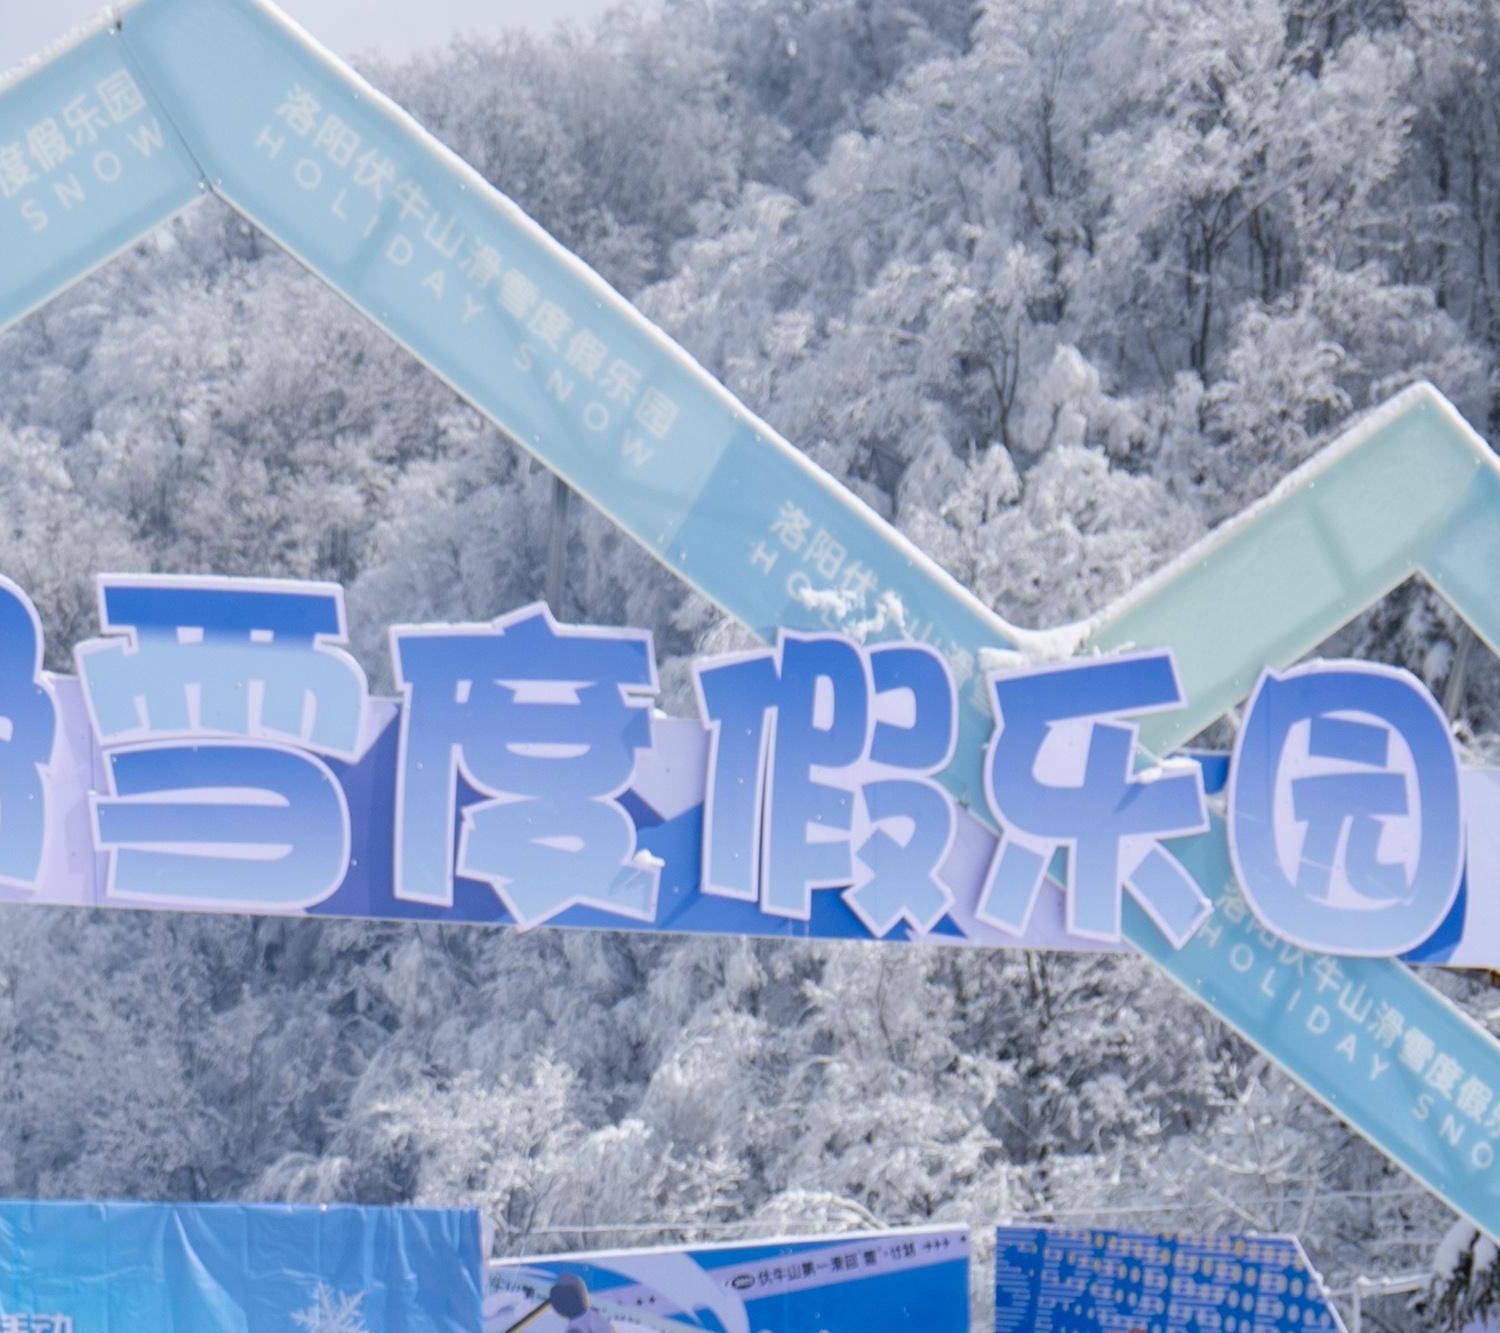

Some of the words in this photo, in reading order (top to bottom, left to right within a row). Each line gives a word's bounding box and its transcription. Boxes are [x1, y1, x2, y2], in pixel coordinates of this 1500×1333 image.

[20, 118, 166, 232] SNOW
[255, 124, 485, 325] HOLIDAY
[513, 341, 657, 468] SNOW
[276, 83, 681, 441] 洛阳伏牛山滑雪度假乐园
[1200, 922, 1390, 1081] HOLIDAY
